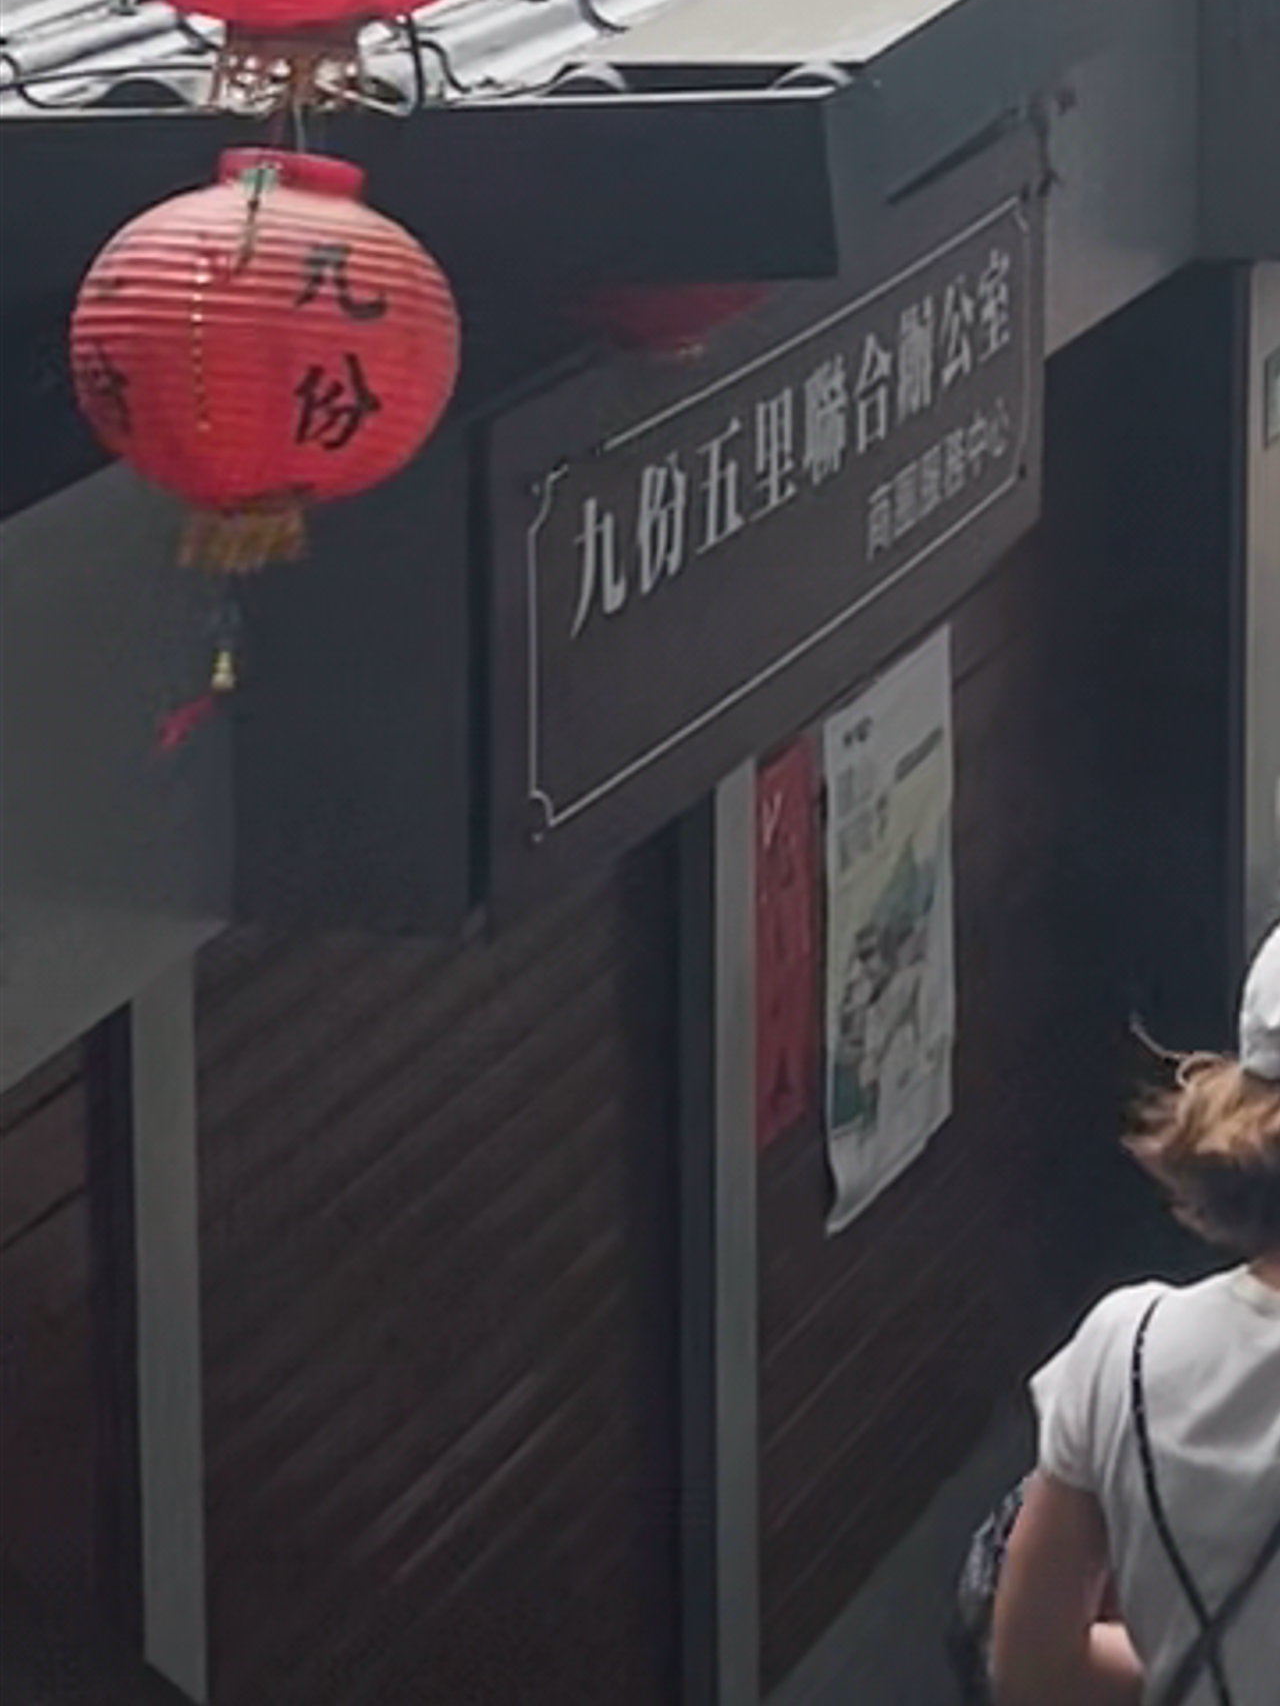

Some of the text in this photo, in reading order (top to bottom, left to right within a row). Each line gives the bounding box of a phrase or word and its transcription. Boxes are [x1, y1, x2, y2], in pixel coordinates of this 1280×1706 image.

[293, 242, 388, 452] 九份
[570, 246, 1012, 640] 九份五里聯合辦公室
